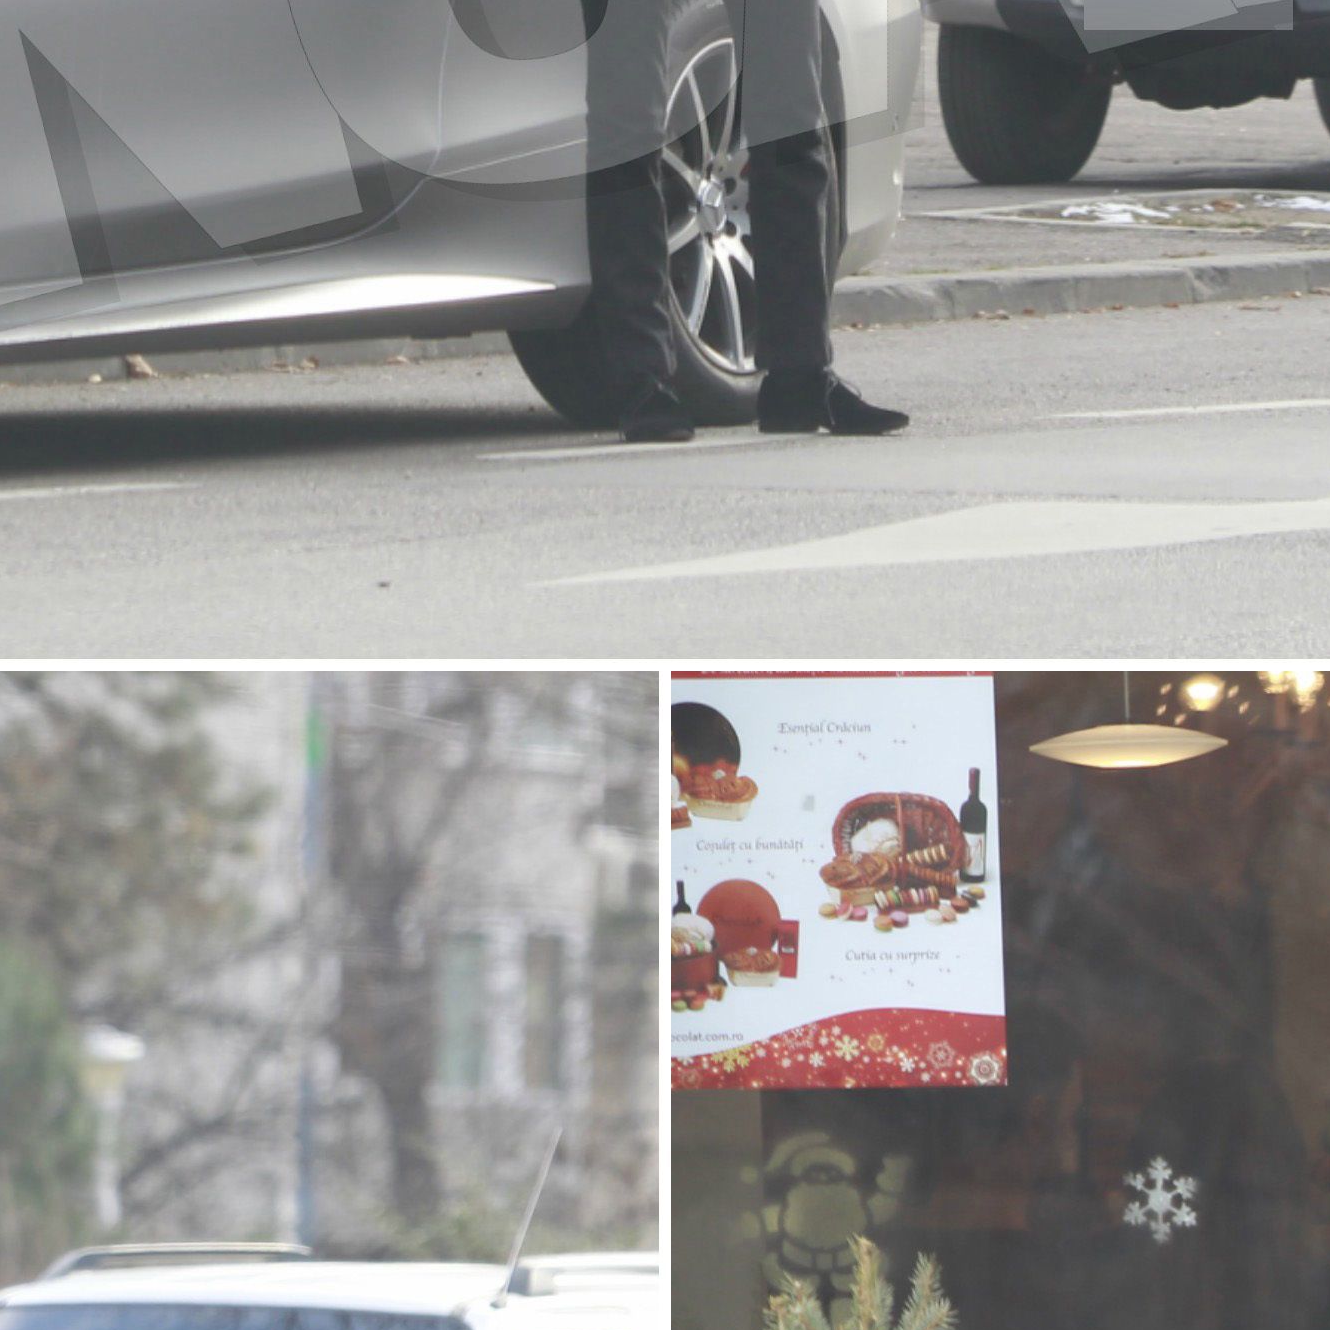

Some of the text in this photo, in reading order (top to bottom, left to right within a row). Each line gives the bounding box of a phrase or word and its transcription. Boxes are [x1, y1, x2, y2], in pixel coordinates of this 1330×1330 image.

[738, 841, 752, 851] cu
[845, 949, 941, 965] Cutia cu surprize
